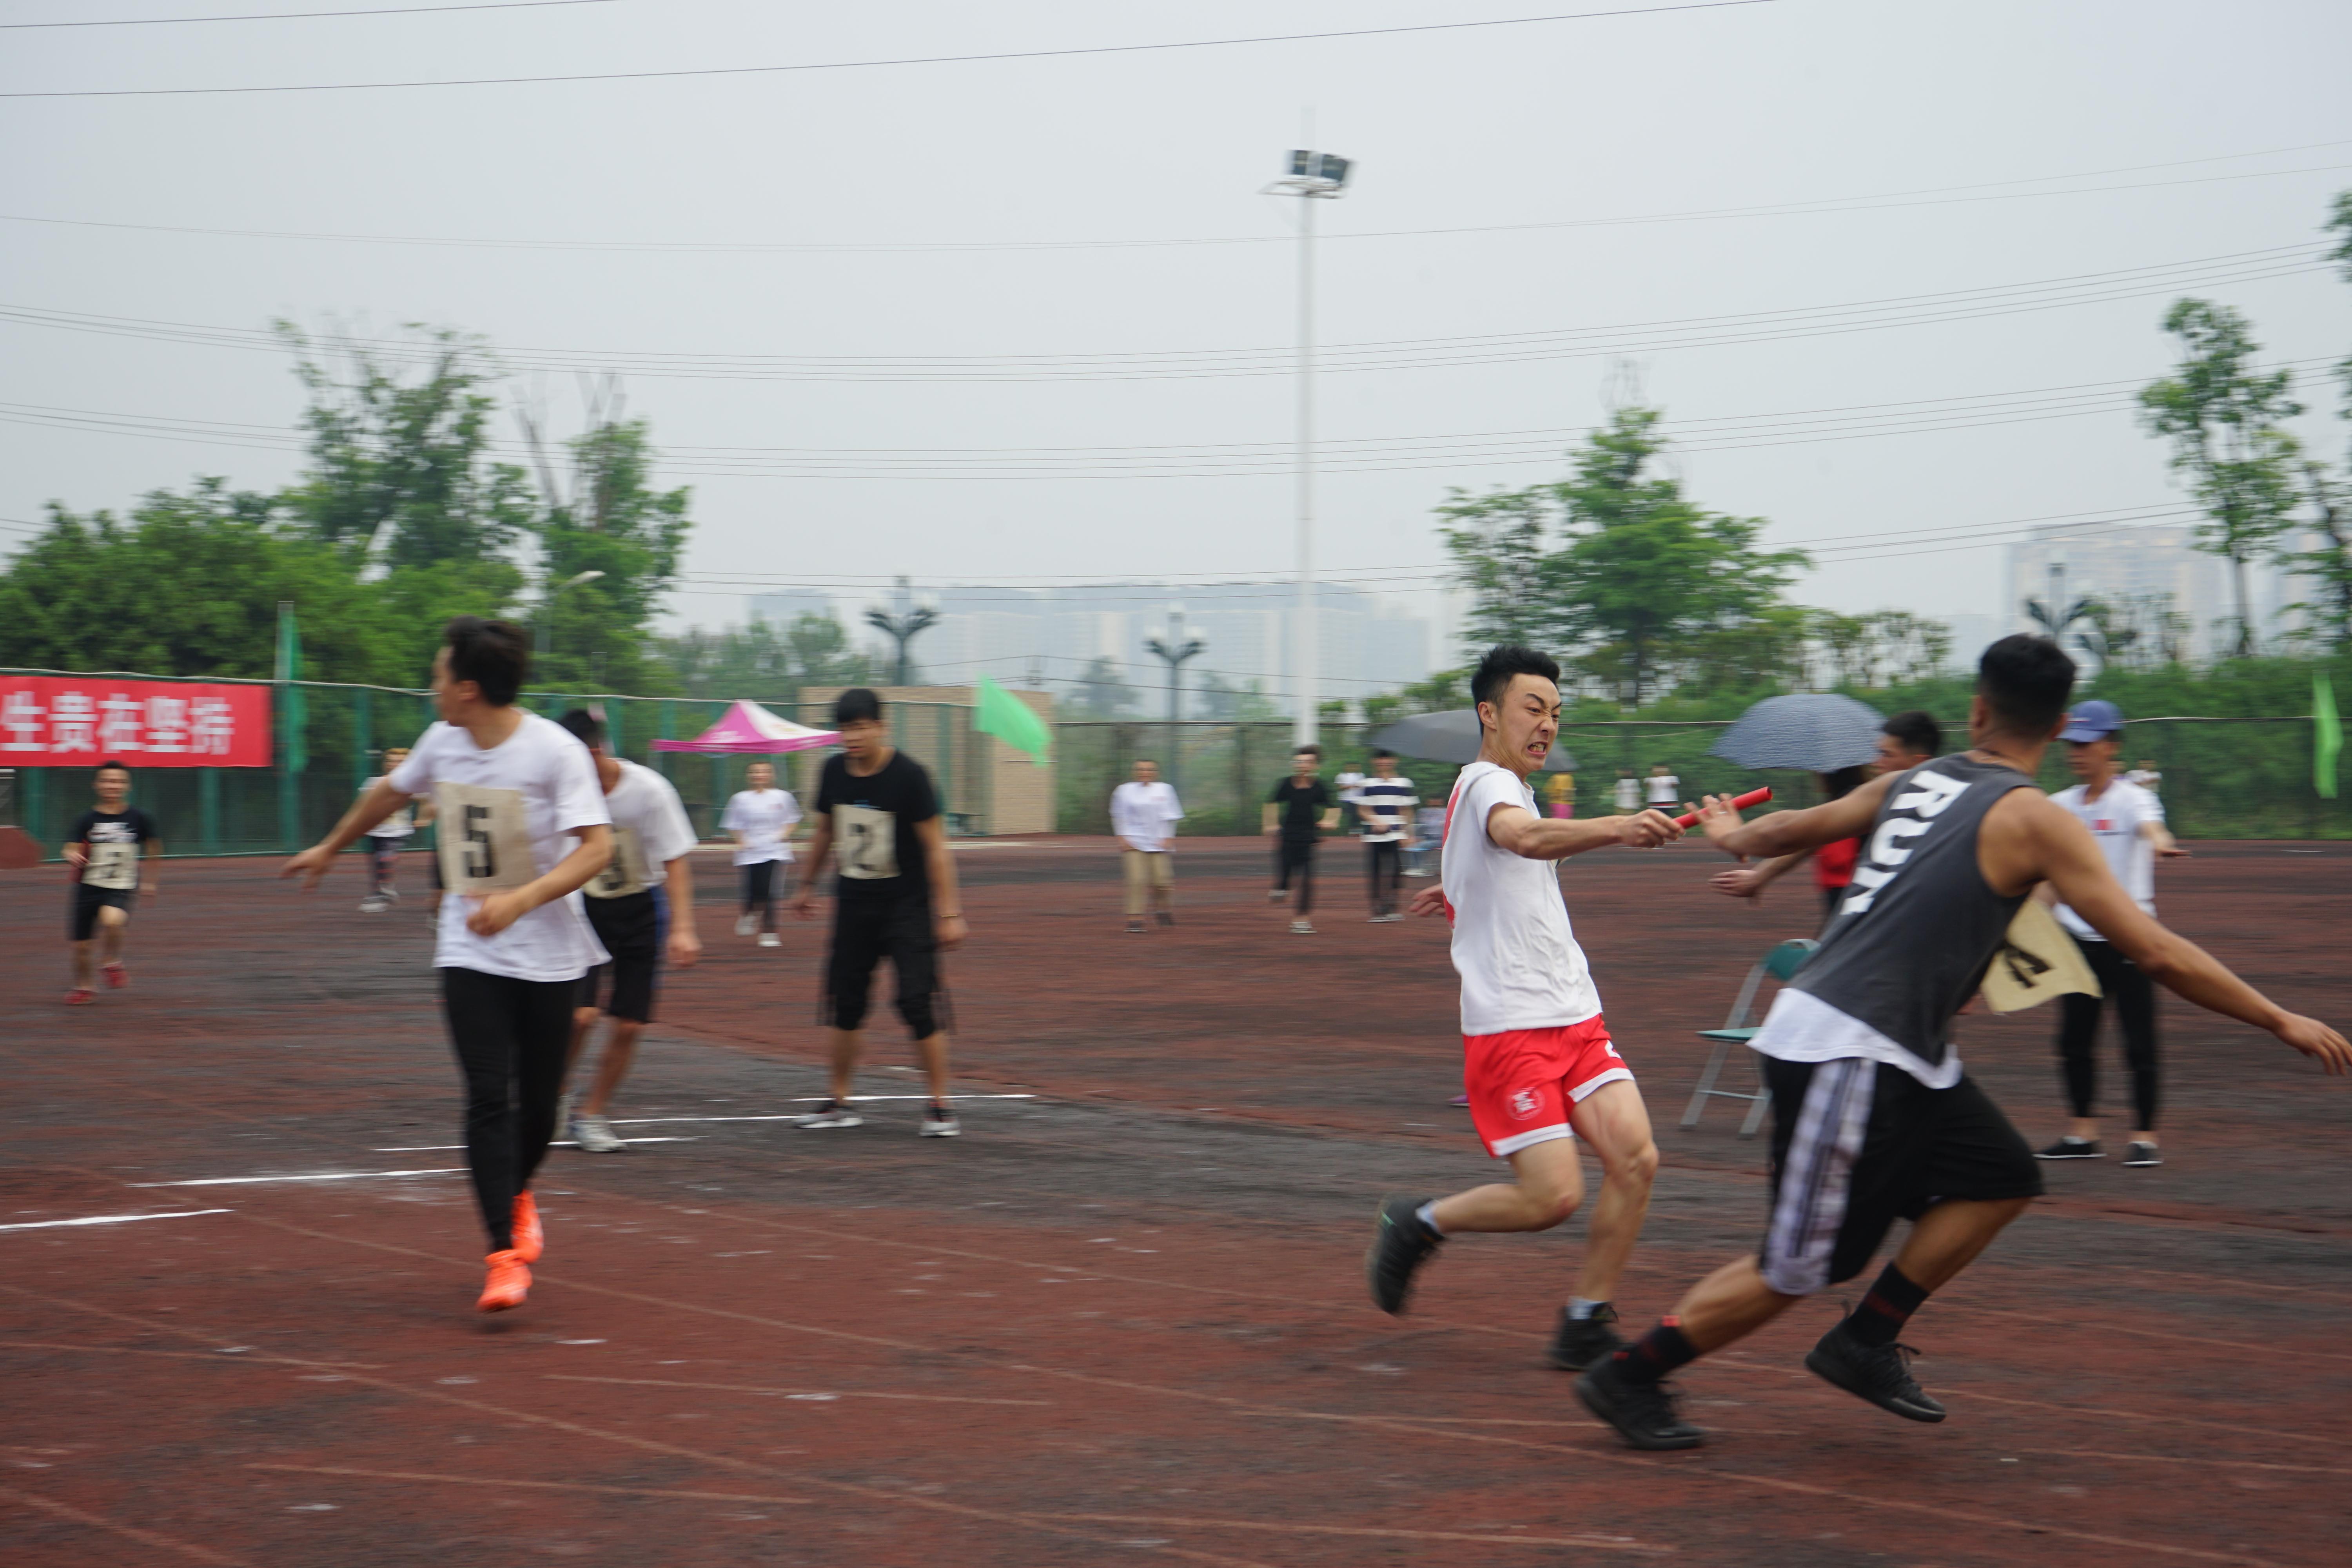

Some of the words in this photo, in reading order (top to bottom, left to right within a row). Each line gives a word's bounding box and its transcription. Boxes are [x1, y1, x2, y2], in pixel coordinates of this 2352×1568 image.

[464, 805, 494, 878] 5
[847, 823, 878, 871] 2
[1839, 770, 1973, 916] RUN
